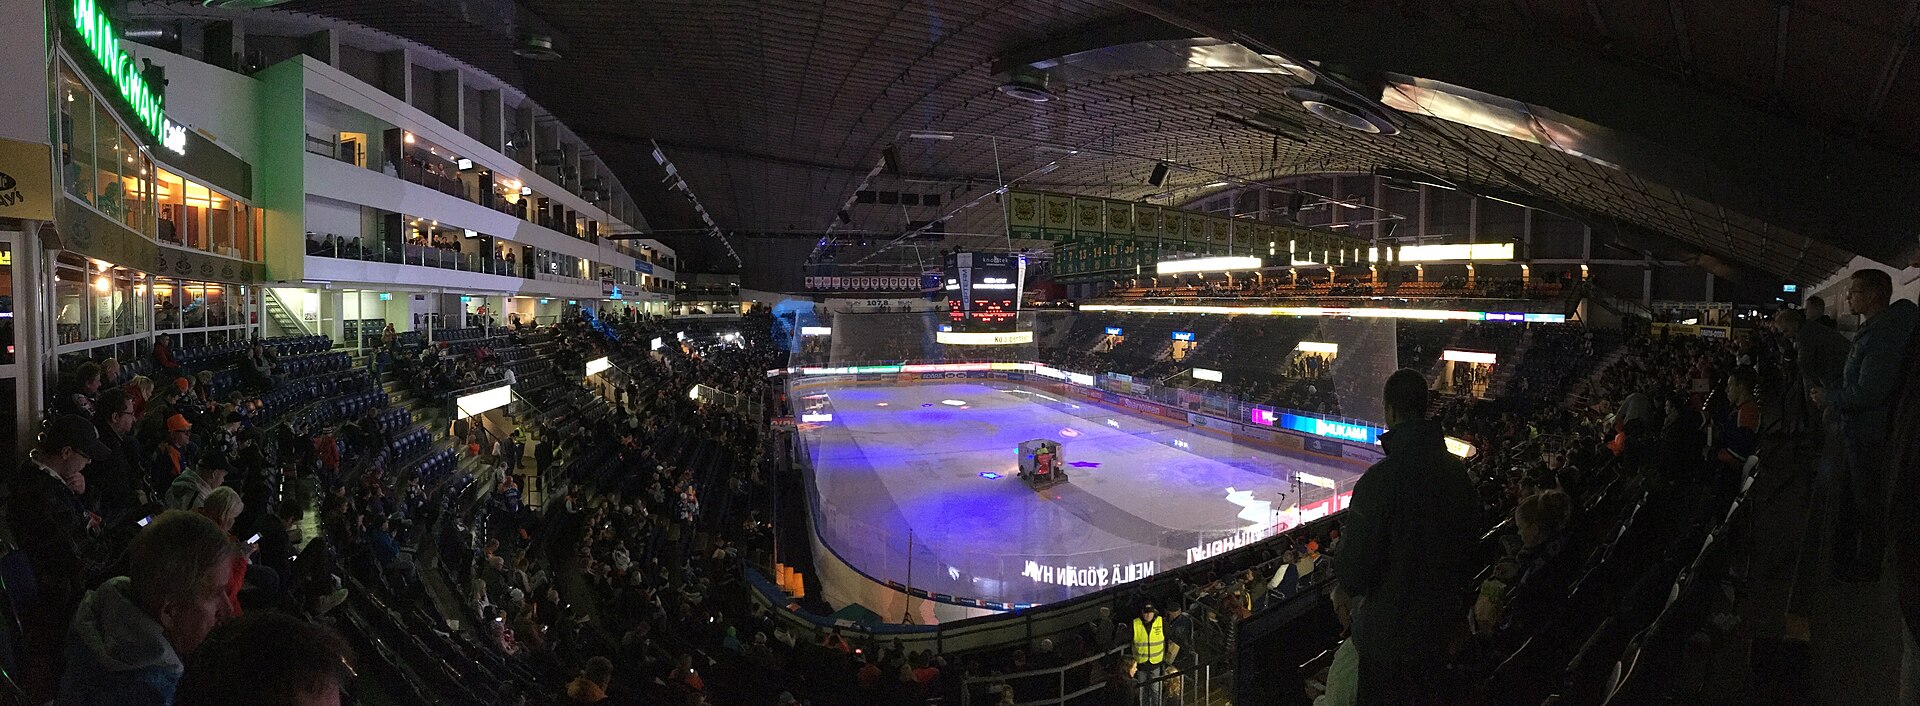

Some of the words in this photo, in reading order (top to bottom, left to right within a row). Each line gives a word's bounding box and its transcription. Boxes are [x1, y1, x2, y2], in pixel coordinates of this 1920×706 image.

[1079, 249, 1087, 260] 13
[1093, 246, 1102, 258] 14
[1108, 244, 1118, 256] 16
